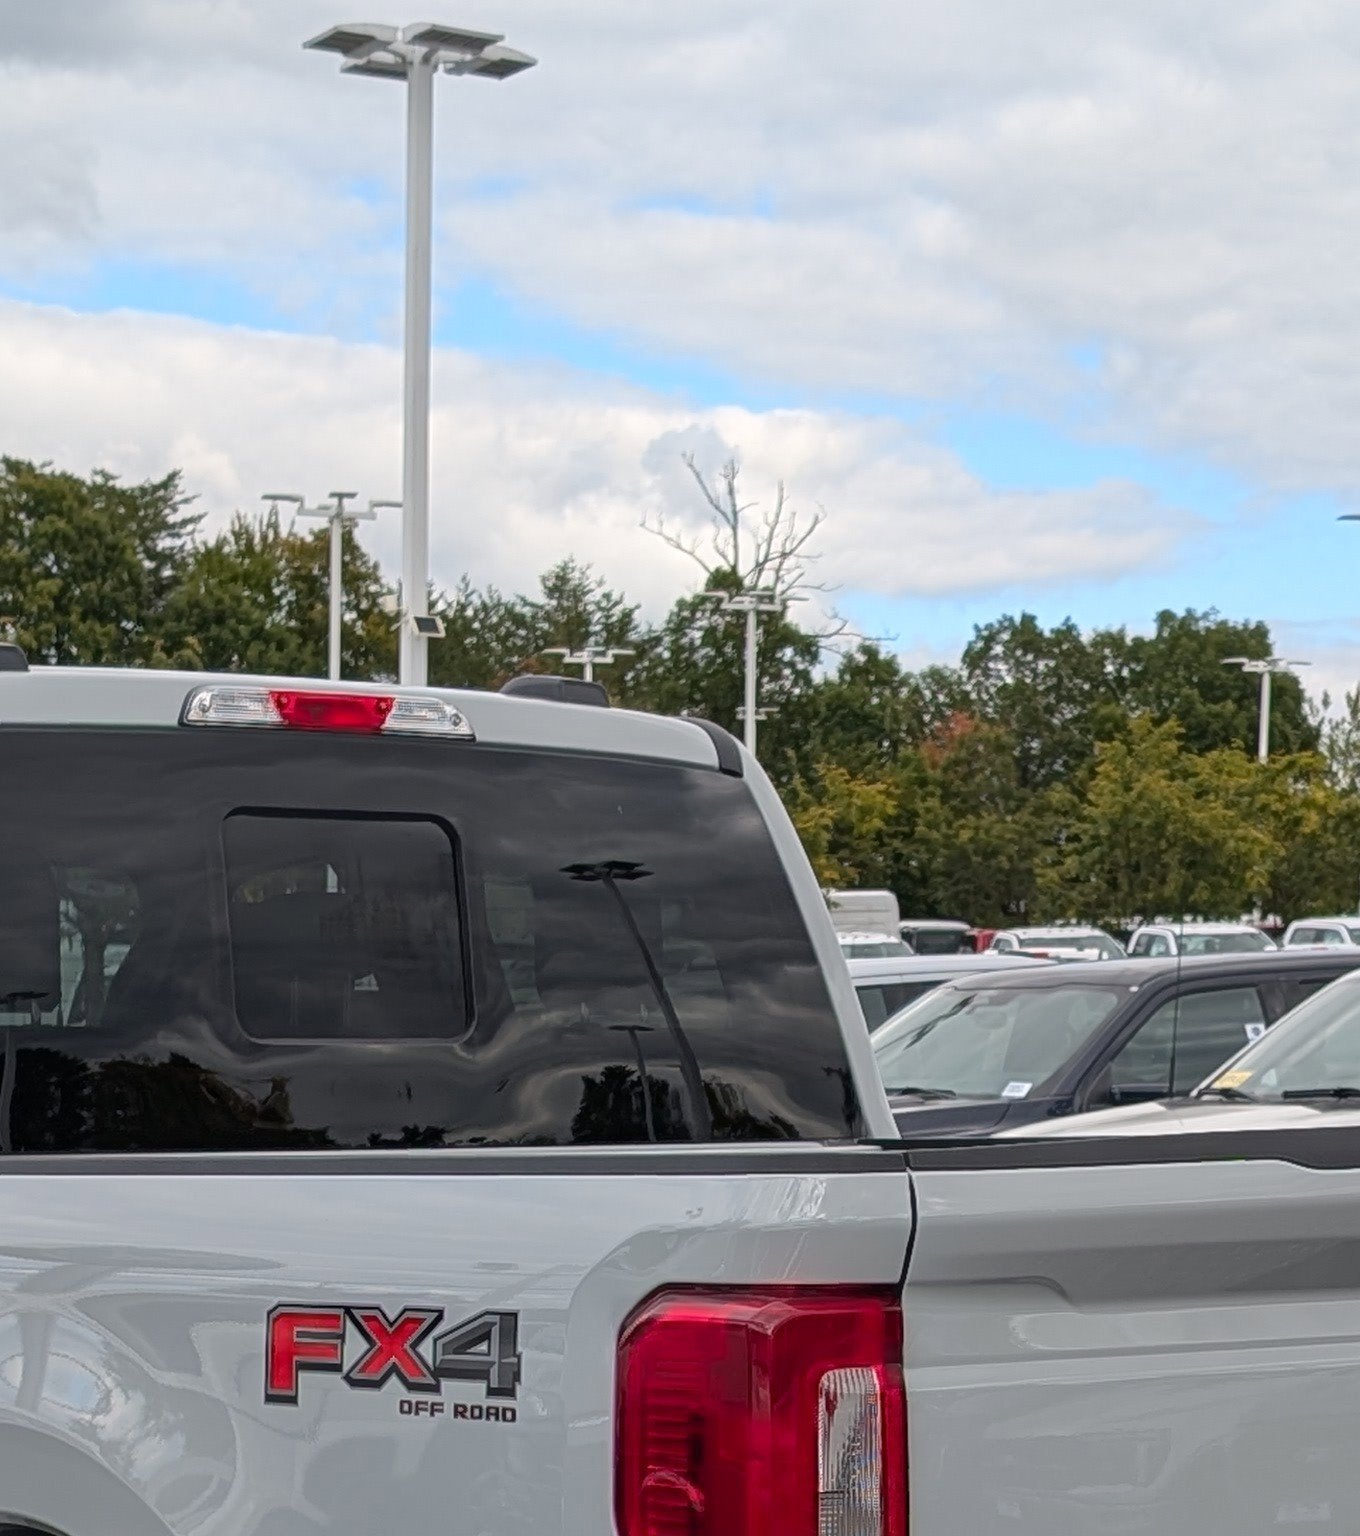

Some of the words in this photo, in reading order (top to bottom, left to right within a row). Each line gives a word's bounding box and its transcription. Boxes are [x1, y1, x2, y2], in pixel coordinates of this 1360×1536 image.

[264, 1302, 522, 1405] FX4
[398, 1398, 445, 1419] OFF
[453, 1403, 518, 1424] ROAD
